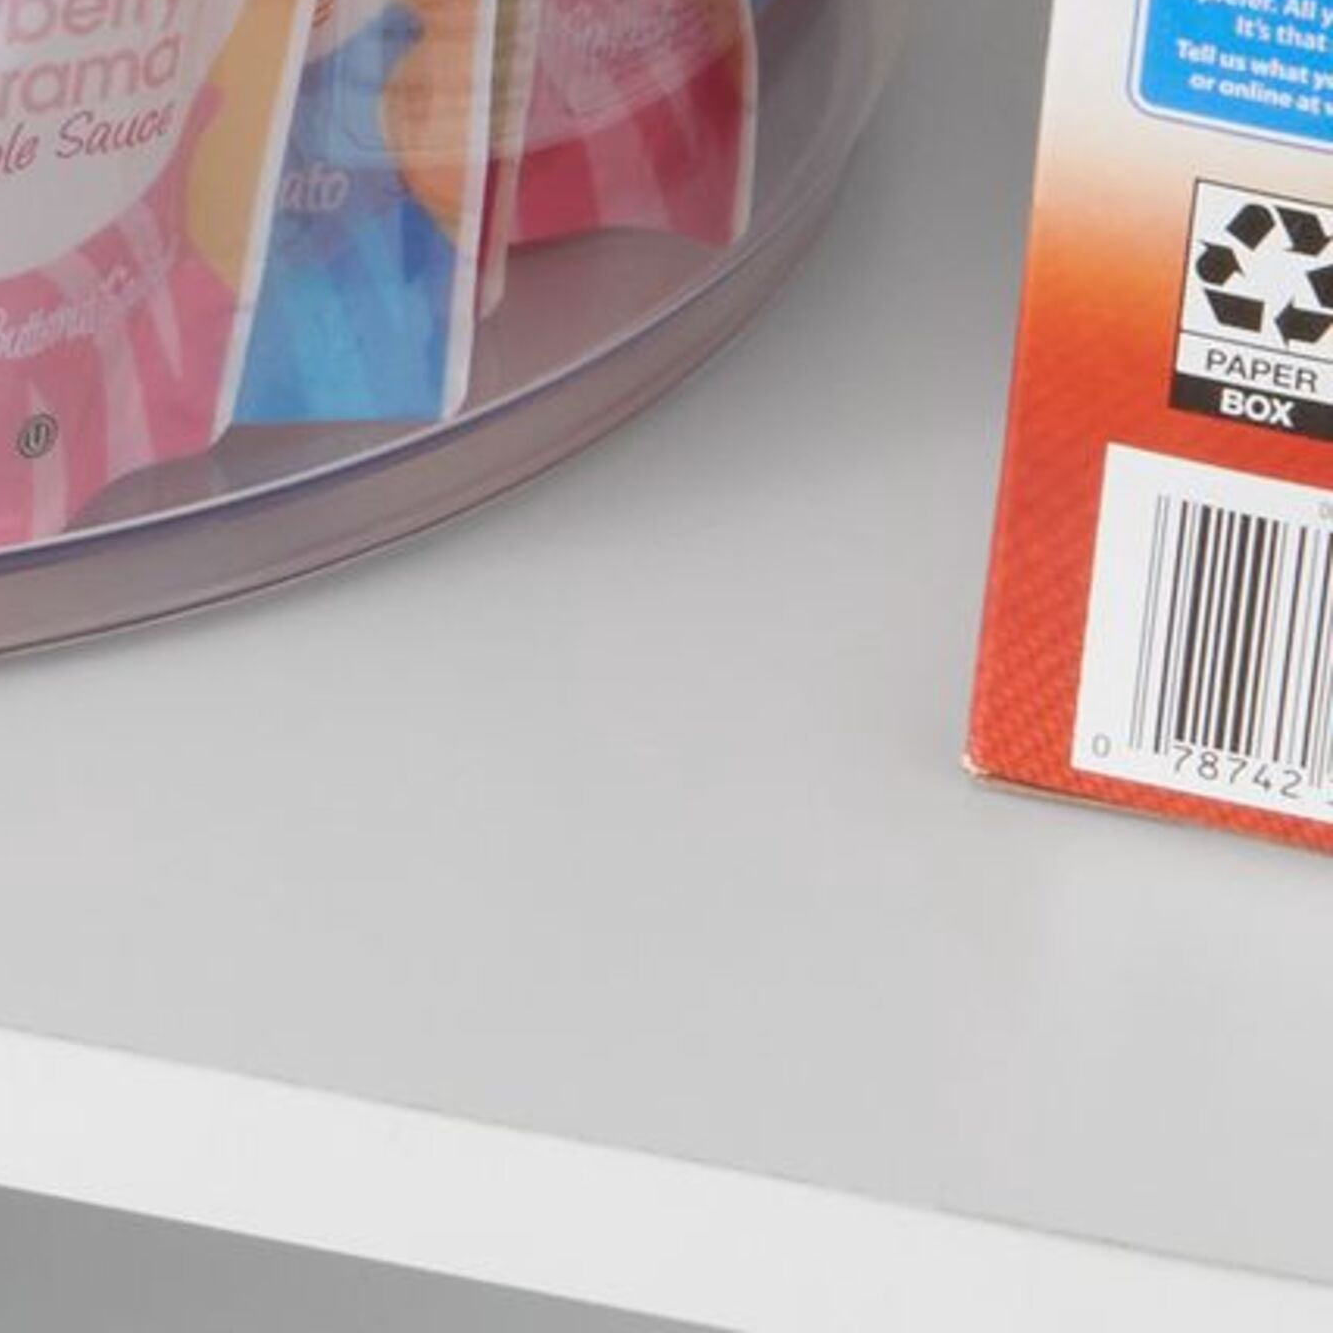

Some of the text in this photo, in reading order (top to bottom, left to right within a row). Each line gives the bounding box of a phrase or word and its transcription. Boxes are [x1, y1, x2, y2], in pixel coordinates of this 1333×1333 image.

[1235, 14, 1328, 53] It's that
[1176, 36, 1218, 66] Tell
[1219, 52, 1247, 72] us
[1250, 56, 1311, 85] what
[1189, 73, 1217, 92] or
[1218, 78, 1294, 110] online
[1295, 94, 1324, 117] at
[55, 101, 178, 161] Sauce
[1205, 346, 1319, 394] PAPER
[1219, 386, 1295, 429] BOX
[1091, 733, 1112, 759] 0
